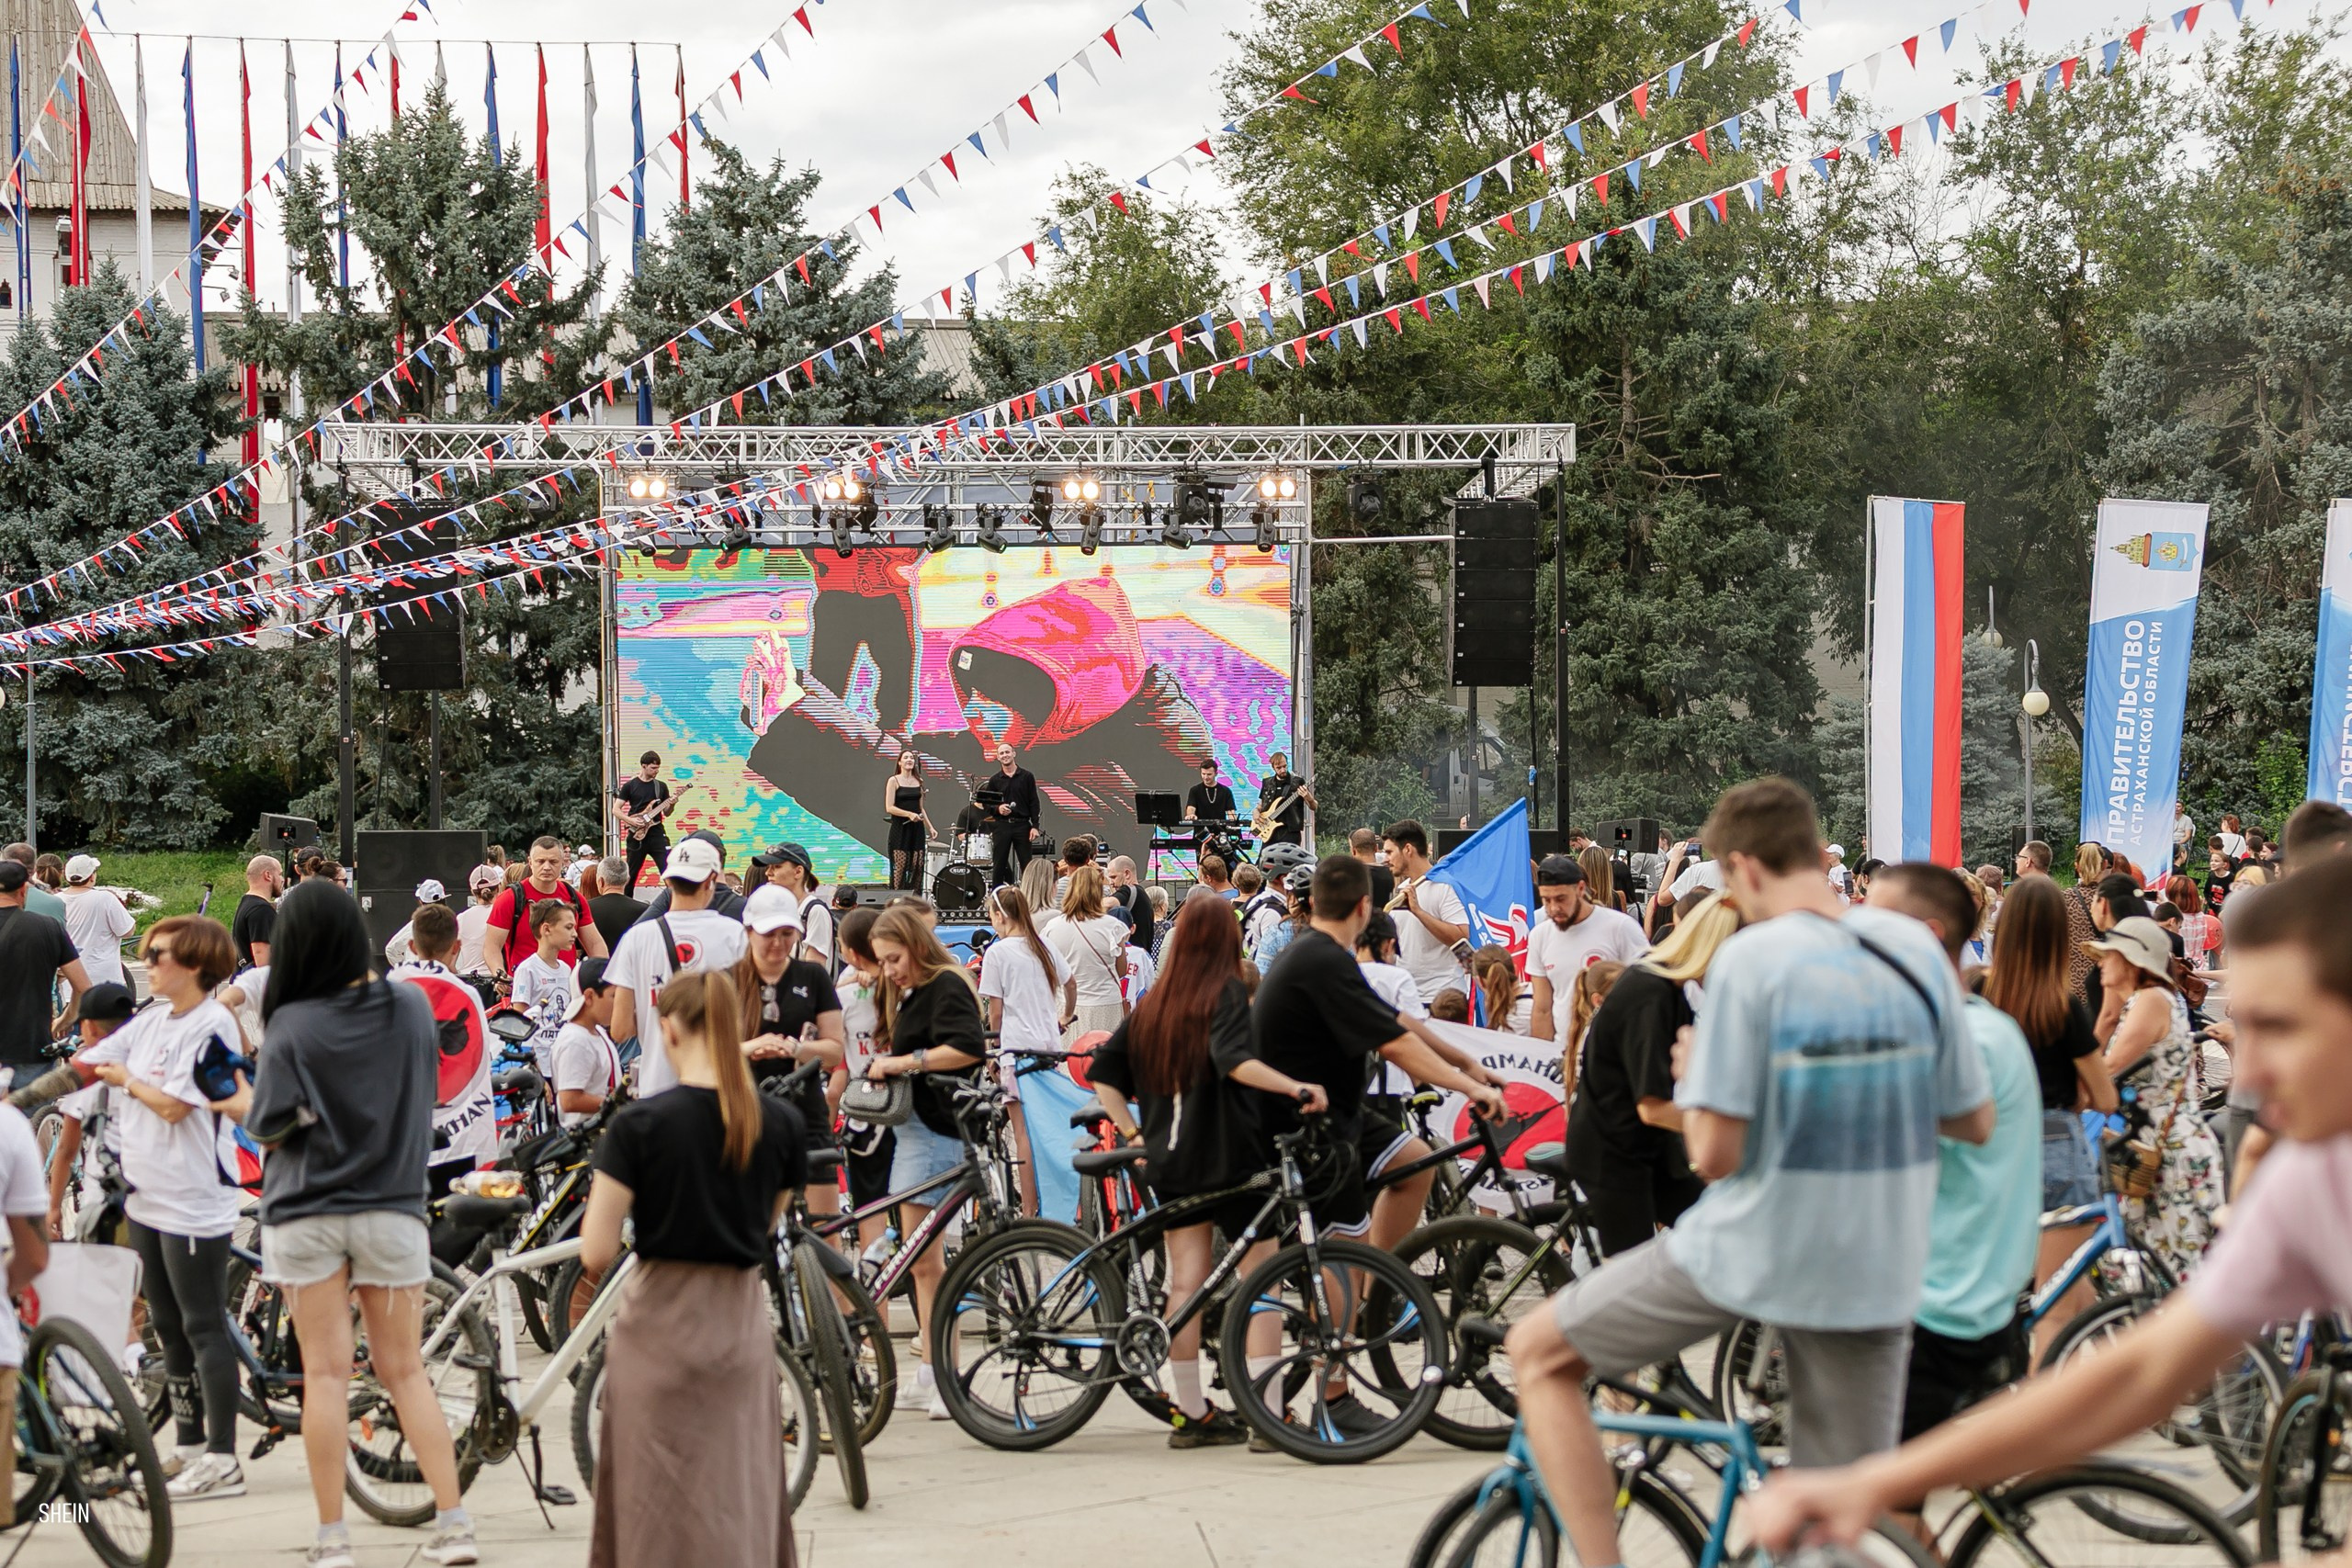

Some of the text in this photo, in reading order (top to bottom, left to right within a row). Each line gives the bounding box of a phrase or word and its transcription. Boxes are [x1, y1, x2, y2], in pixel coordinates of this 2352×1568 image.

[2106, 619, 2145, 845] ПРАВИТЕЛЬСТВО
[2130, 620, 2164, 846] АСТРАХАНСКОЙ ОБЛАСТИ
